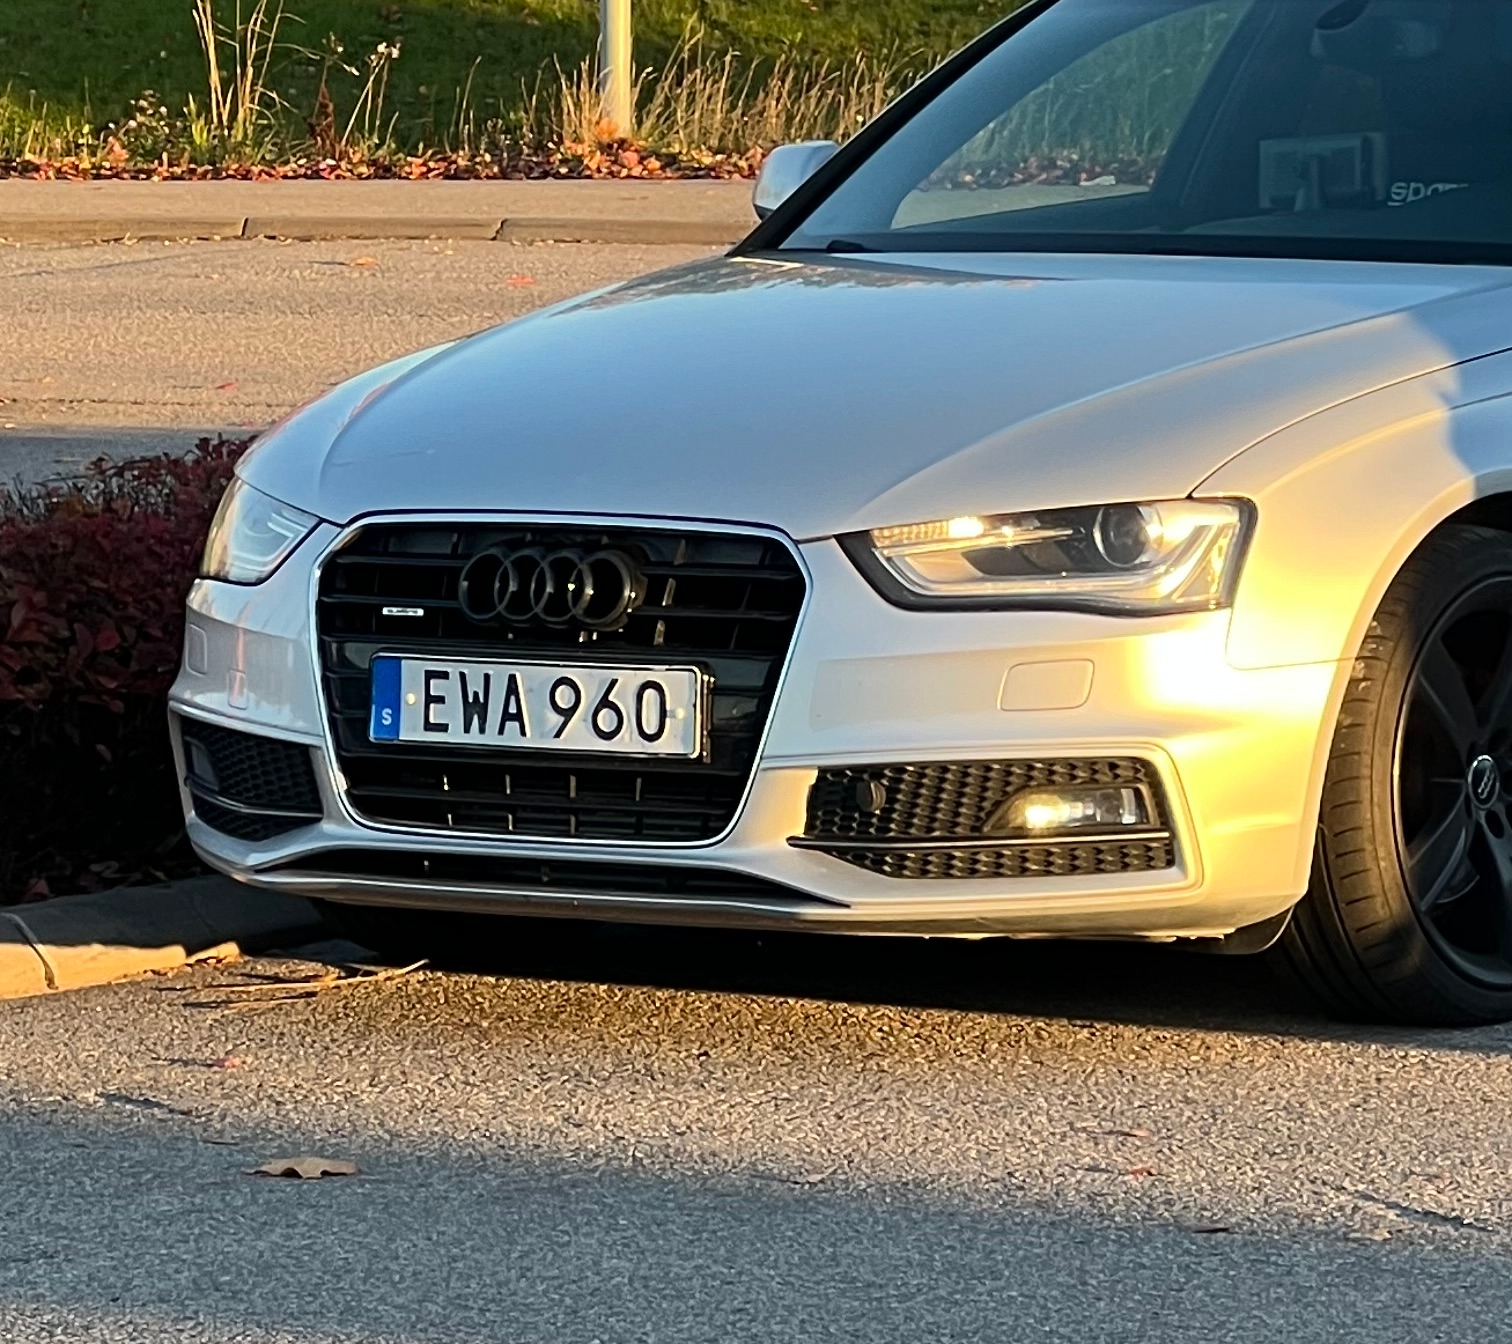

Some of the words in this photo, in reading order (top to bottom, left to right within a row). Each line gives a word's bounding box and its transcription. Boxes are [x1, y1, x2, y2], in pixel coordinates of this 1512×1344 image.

[381, 707, 392, 725] S
[423, 669, 529, 738] EWA
[549, 676, 667, 743] 960
